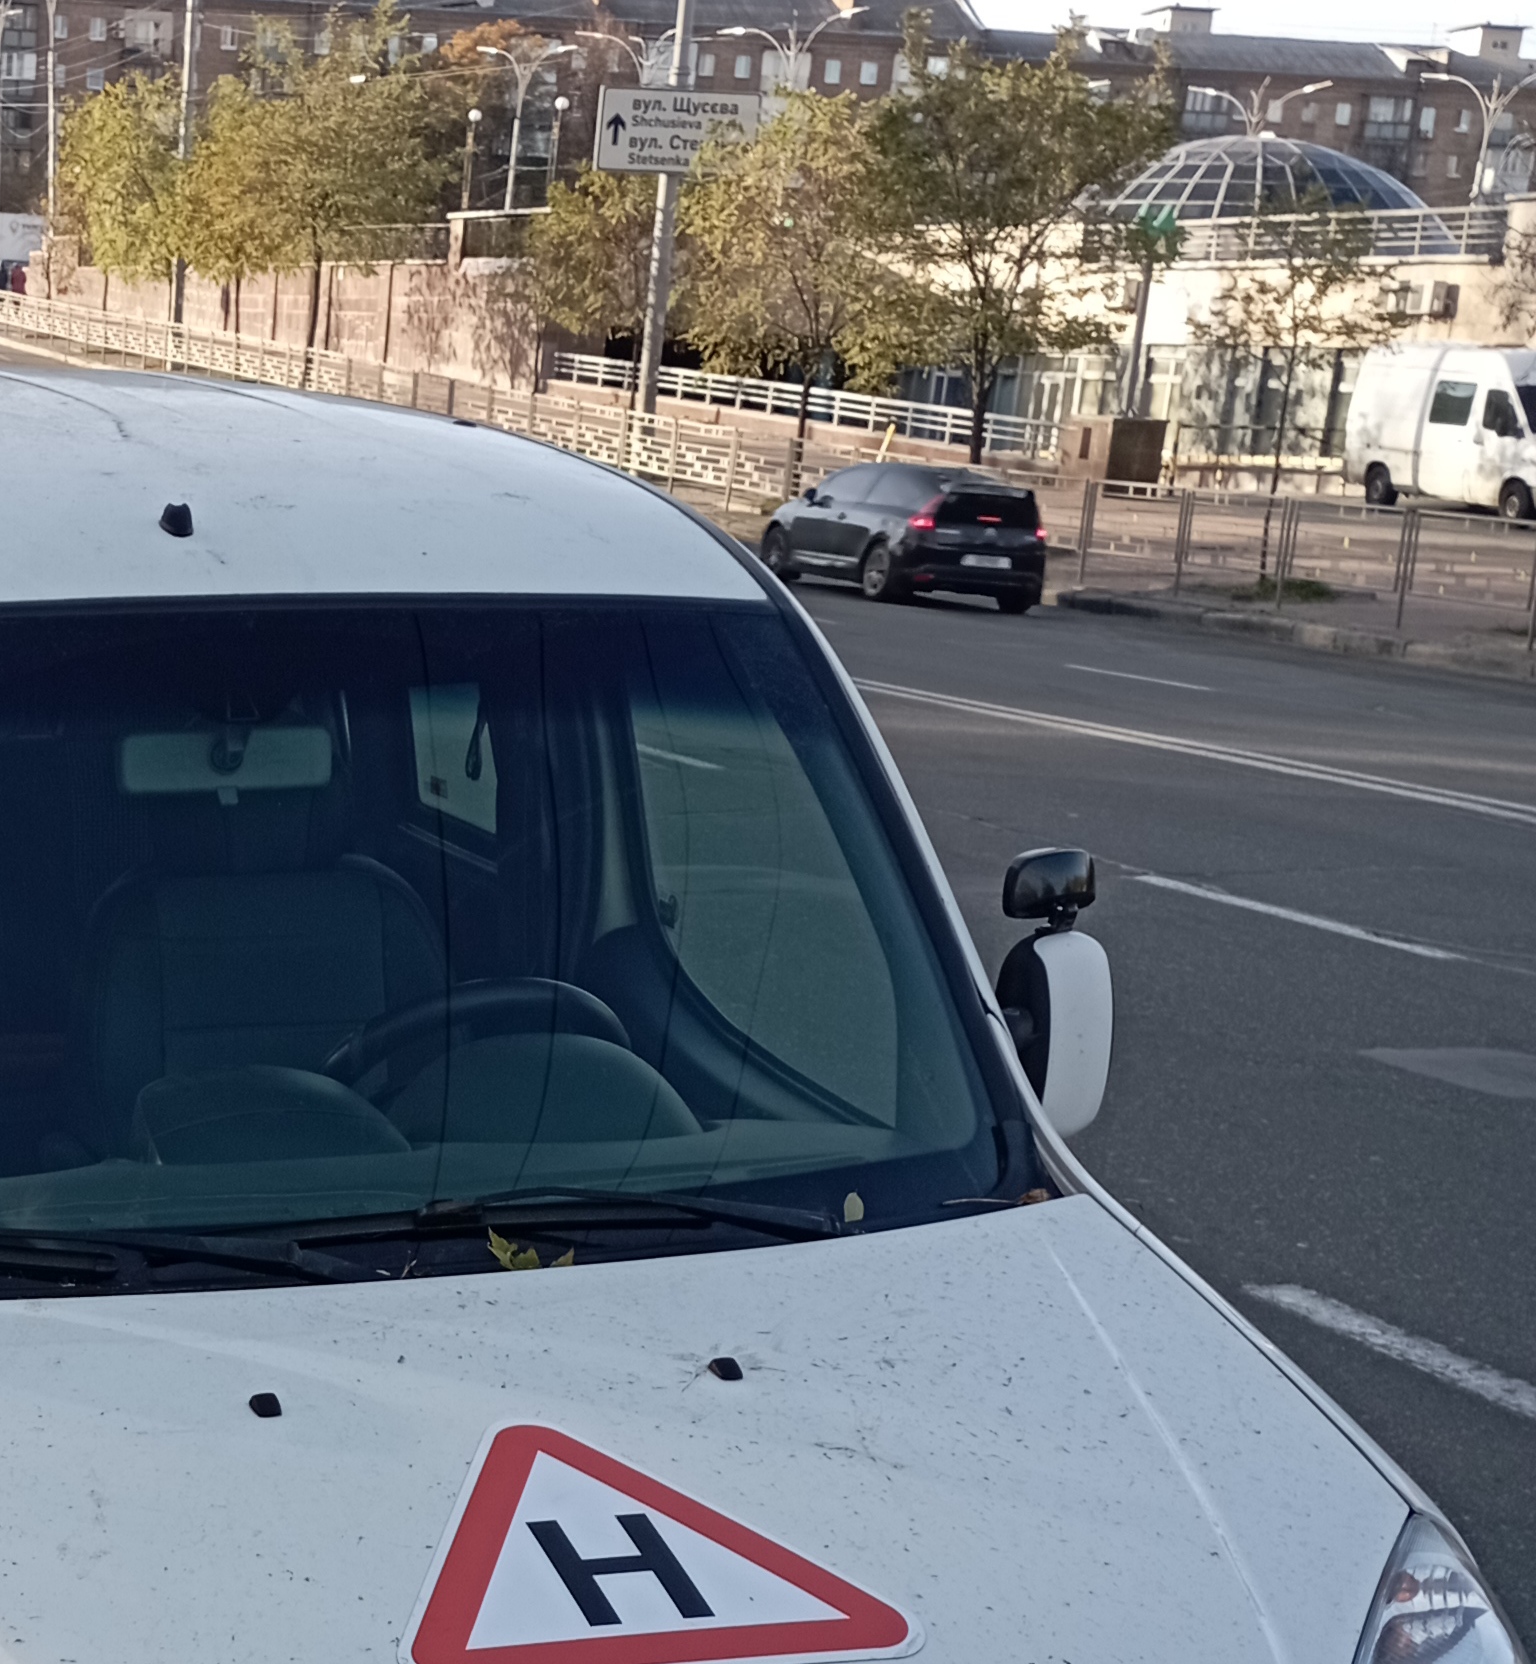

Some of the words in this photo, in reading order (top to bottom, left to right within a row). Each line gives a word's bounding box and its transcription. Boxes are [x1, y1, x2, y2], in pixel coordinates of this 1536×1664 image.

[632, 98, 667, 114] вул.
[672, 96, 740, 117] Щусєва
[631, 114, 702, 130] Shchusieva
[628, 136, 663, 152] вул.
[627, 152, 690, 167] Stetsenka
[525, 1512, 716, 1627] Н
